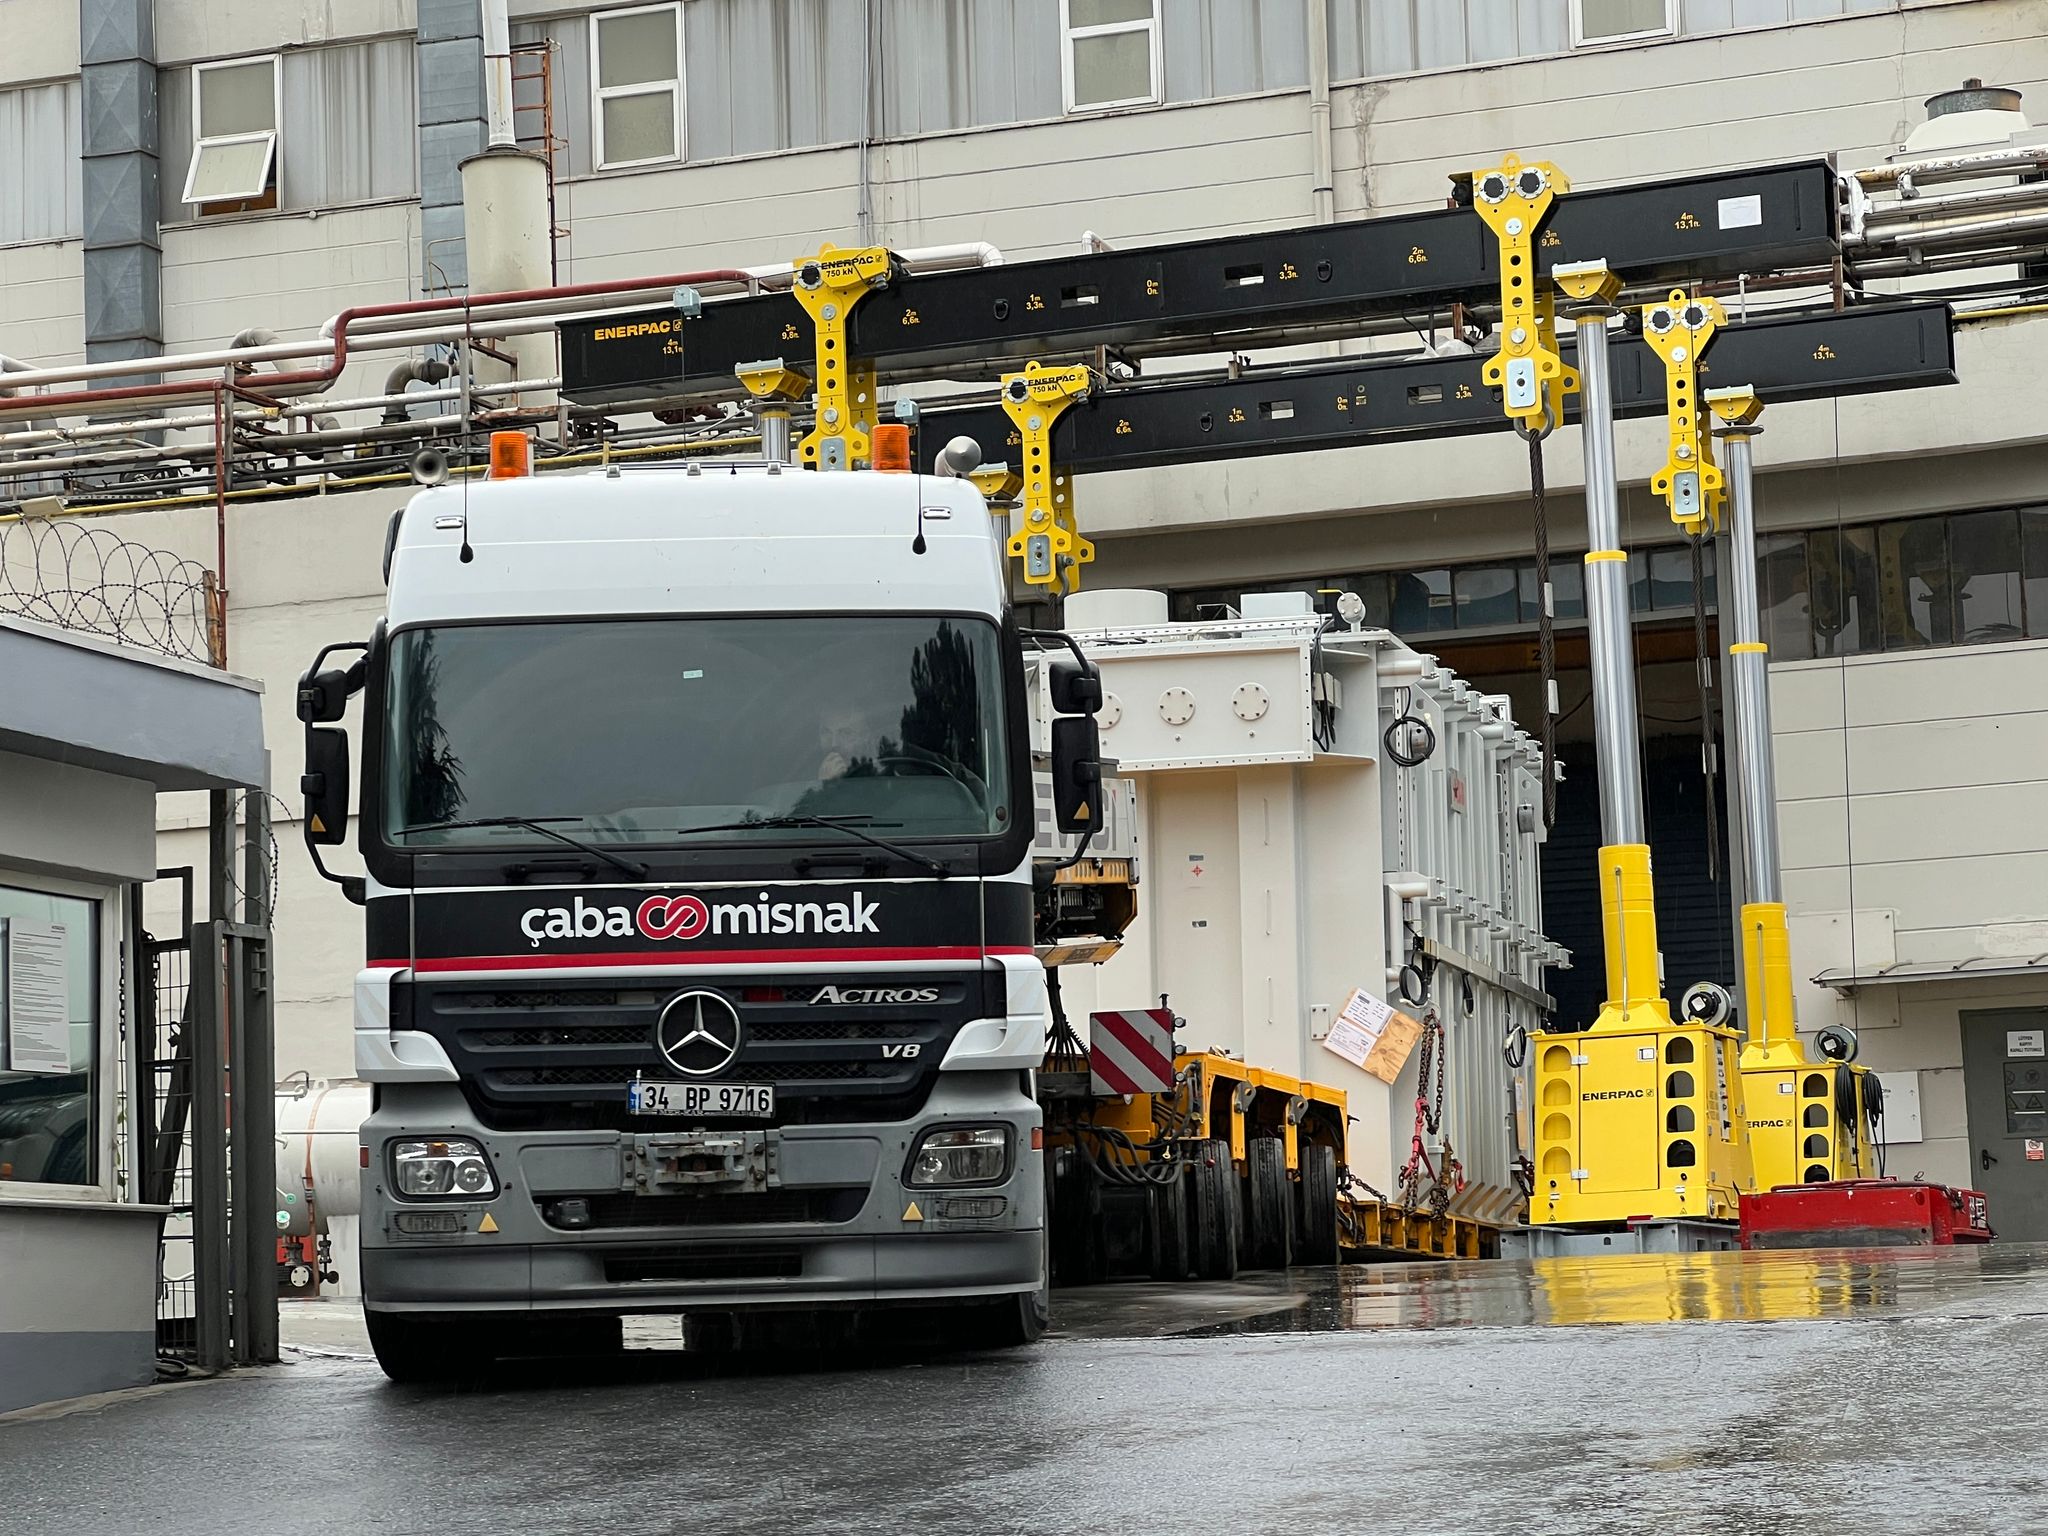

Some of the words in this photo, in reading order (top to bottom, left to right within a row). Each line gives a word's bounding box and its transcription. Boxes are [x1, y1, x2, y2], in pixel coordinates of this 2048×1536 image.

[821, 256, 874, 270] ENERPAC
[826, 270, 840, 278] 750
[842, 267, 854, 276] kN
[594, 321, 670, 341] ENERPAC
[1033, 386, 1046, 394] 750
[520, 896, 635, 948] çaba
[712, 891, 881, 935] misnak
[882, 1044, 922, 1059] V8
[645, 1086, 669, 1110] 34
[686, 1087, 709, 1112] BP
[719, 1088, 770, 1112] 9716
[1582, 1089, 1644, 1102] ENERPAC
